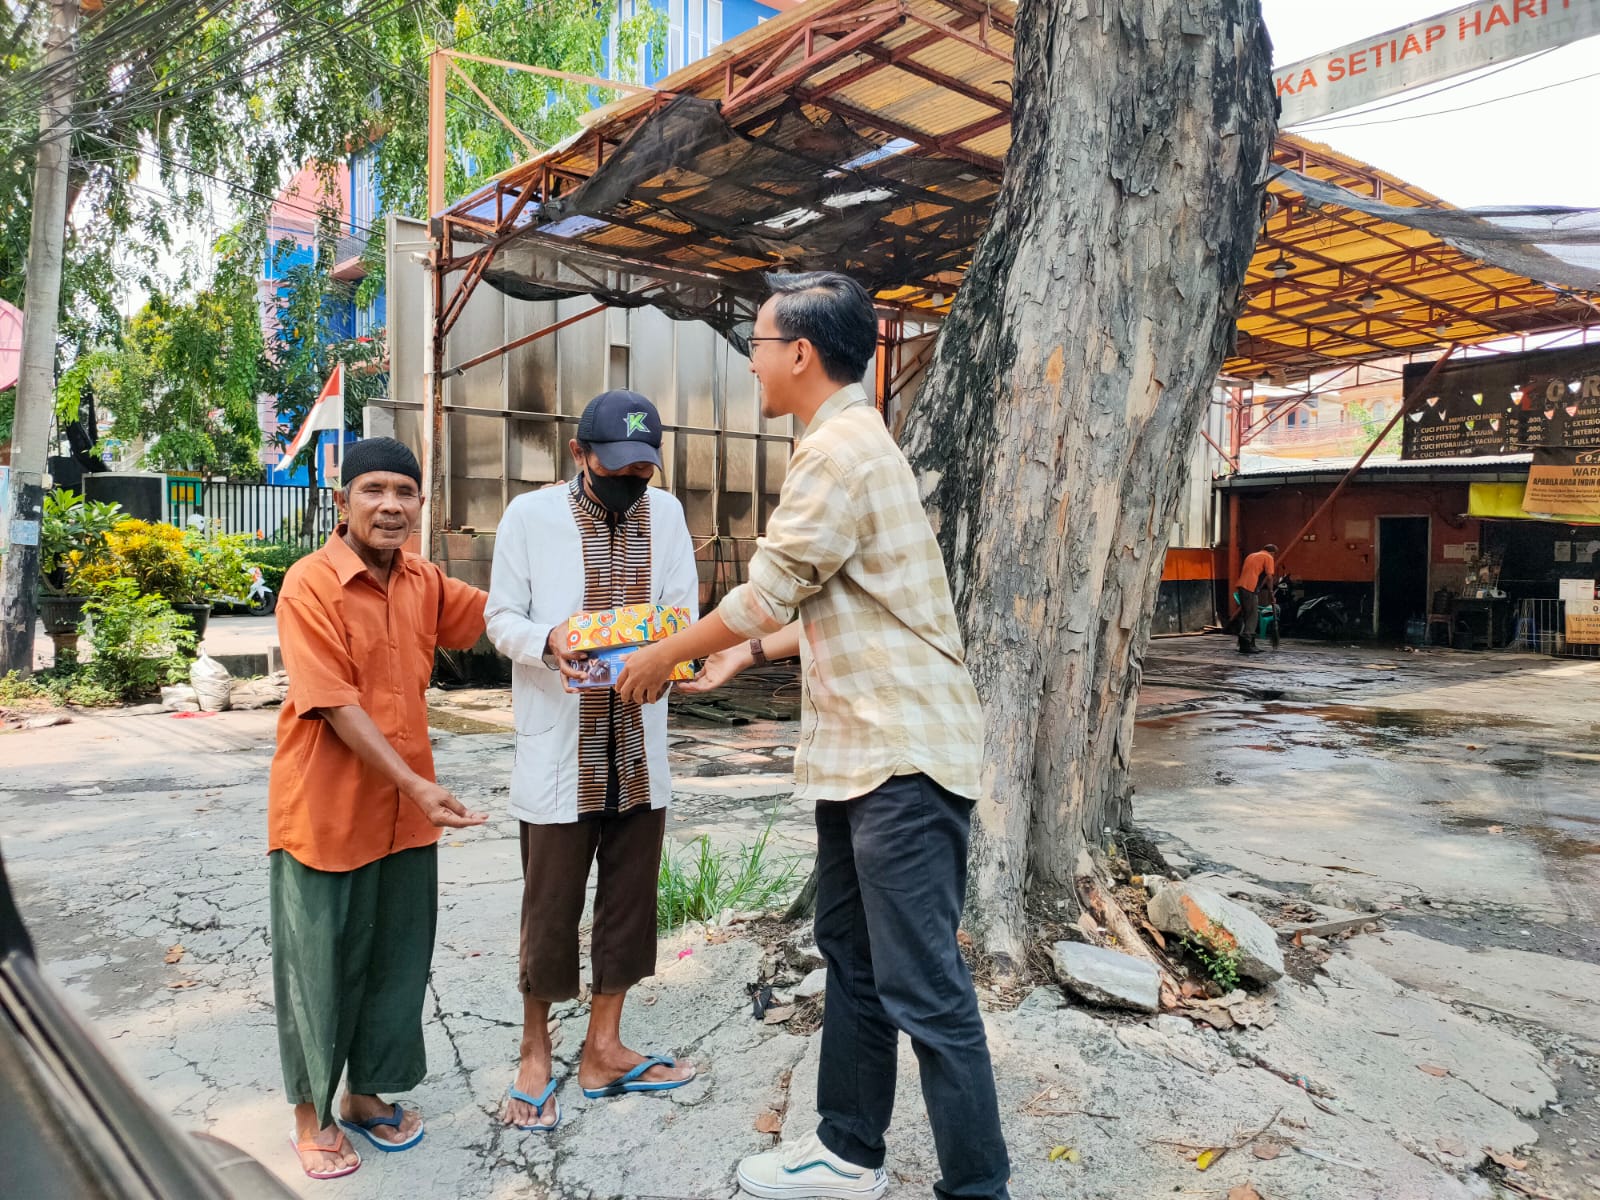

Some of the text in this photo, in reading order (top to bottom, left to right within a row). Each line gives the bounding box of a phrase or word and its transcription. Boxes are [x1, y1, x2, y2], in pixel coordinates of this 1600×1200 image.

[1326, 24, 1447, 82] SETIAP
[1459, 0, 1548, 41] HARI
[1420, 426, 1435, 434] CUCI
